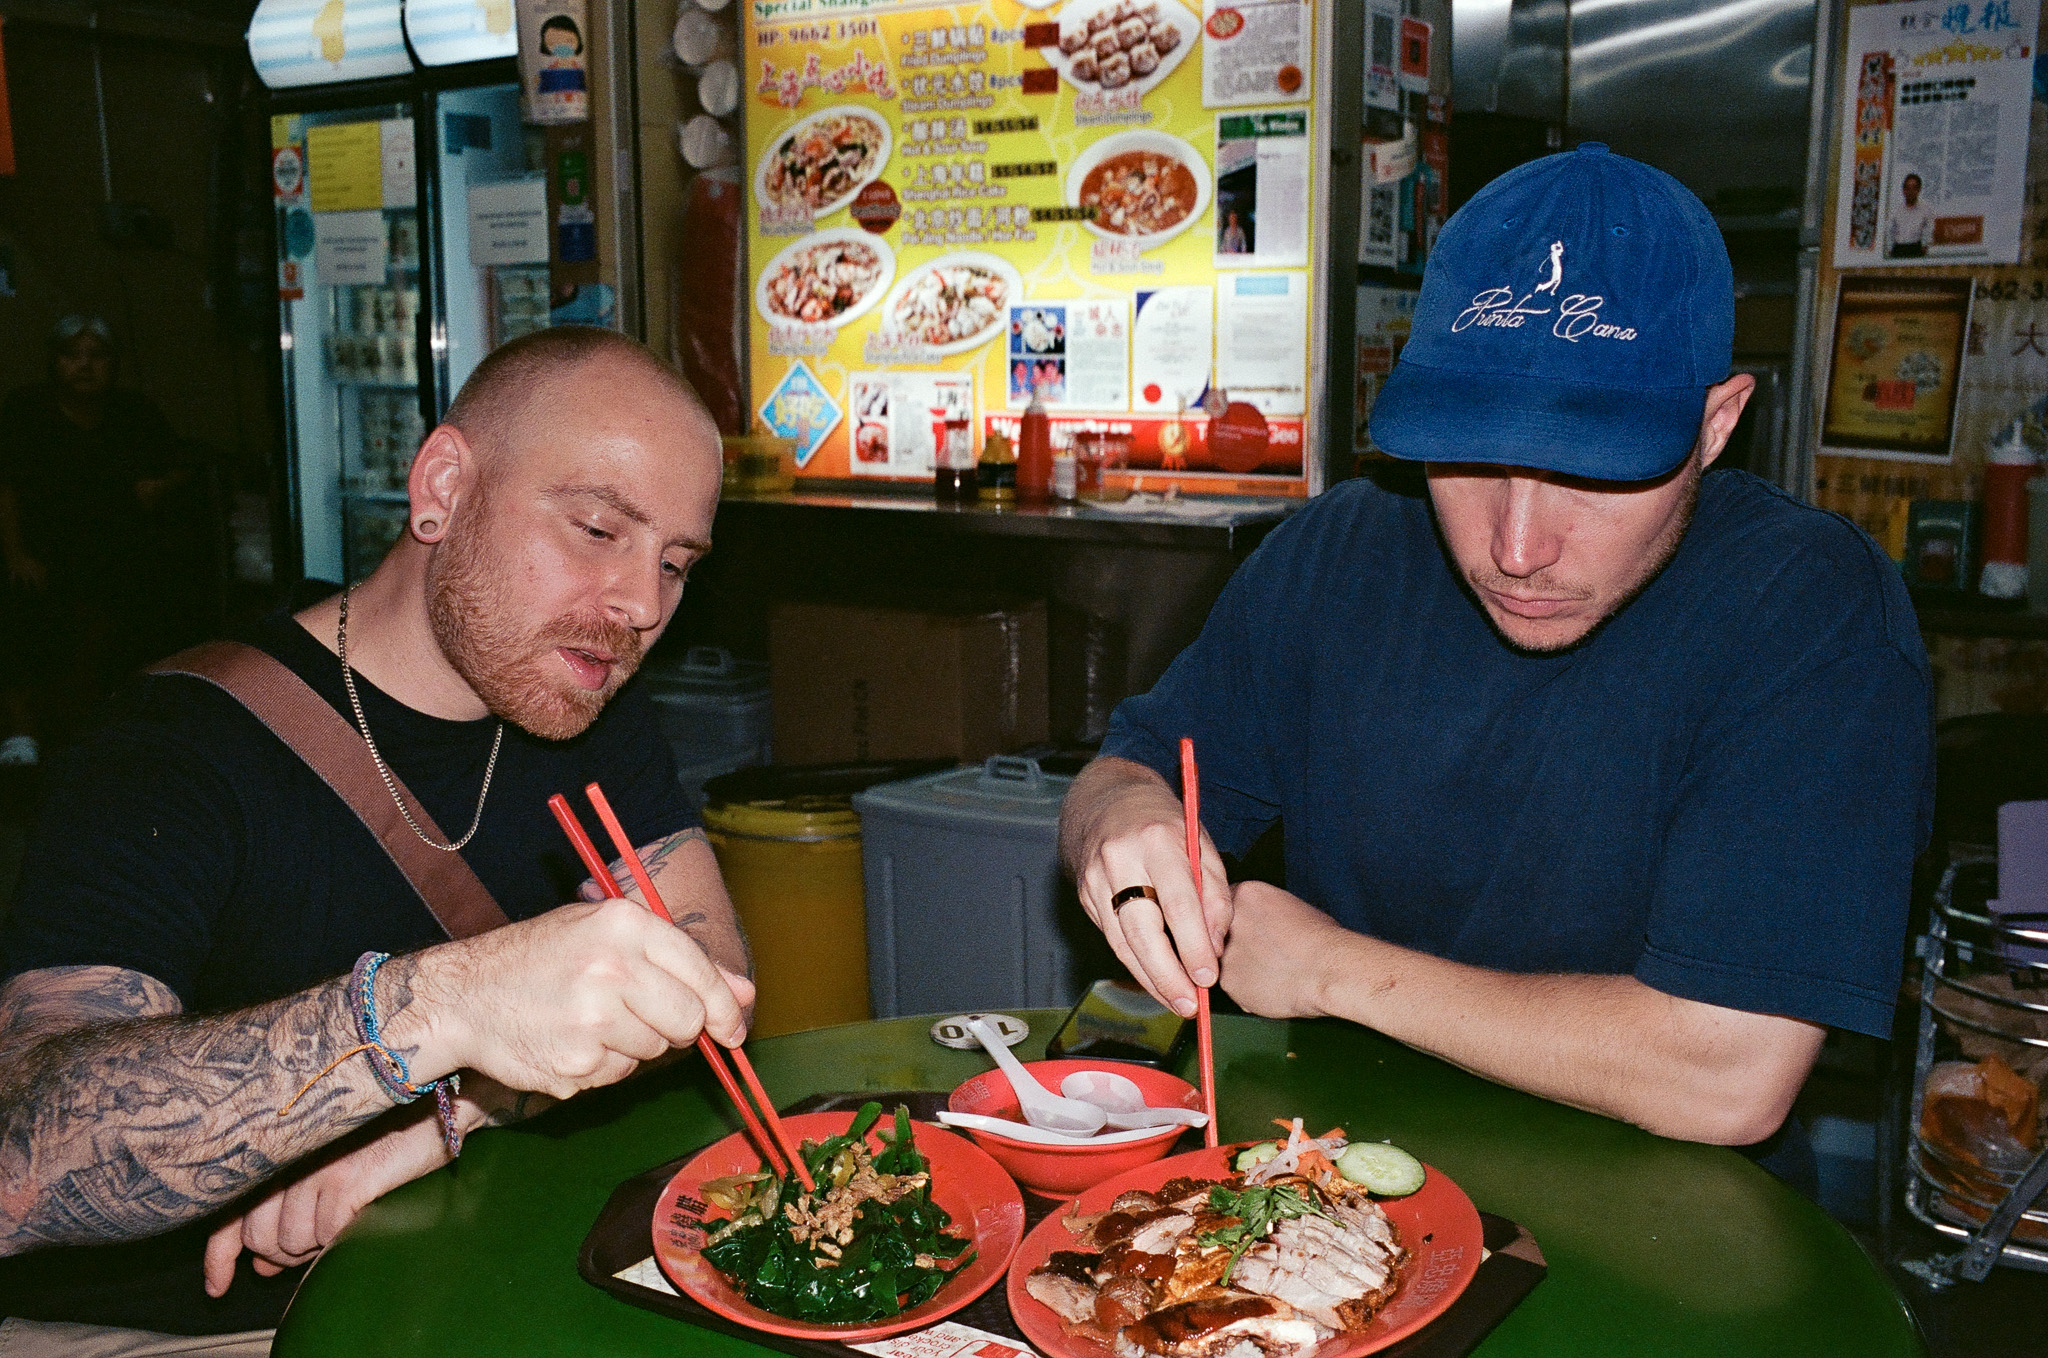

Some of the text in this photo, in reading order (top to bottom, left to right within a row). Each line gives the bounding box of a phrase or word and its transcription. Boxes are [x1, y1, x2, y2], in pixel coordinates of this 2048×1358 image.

[1451, 285, 1550, 333] Punta
[1552, 293, 1638, 343] Cana
[934, 1332, 962, 1343] and
[910, 1346, 943, 1357] your
